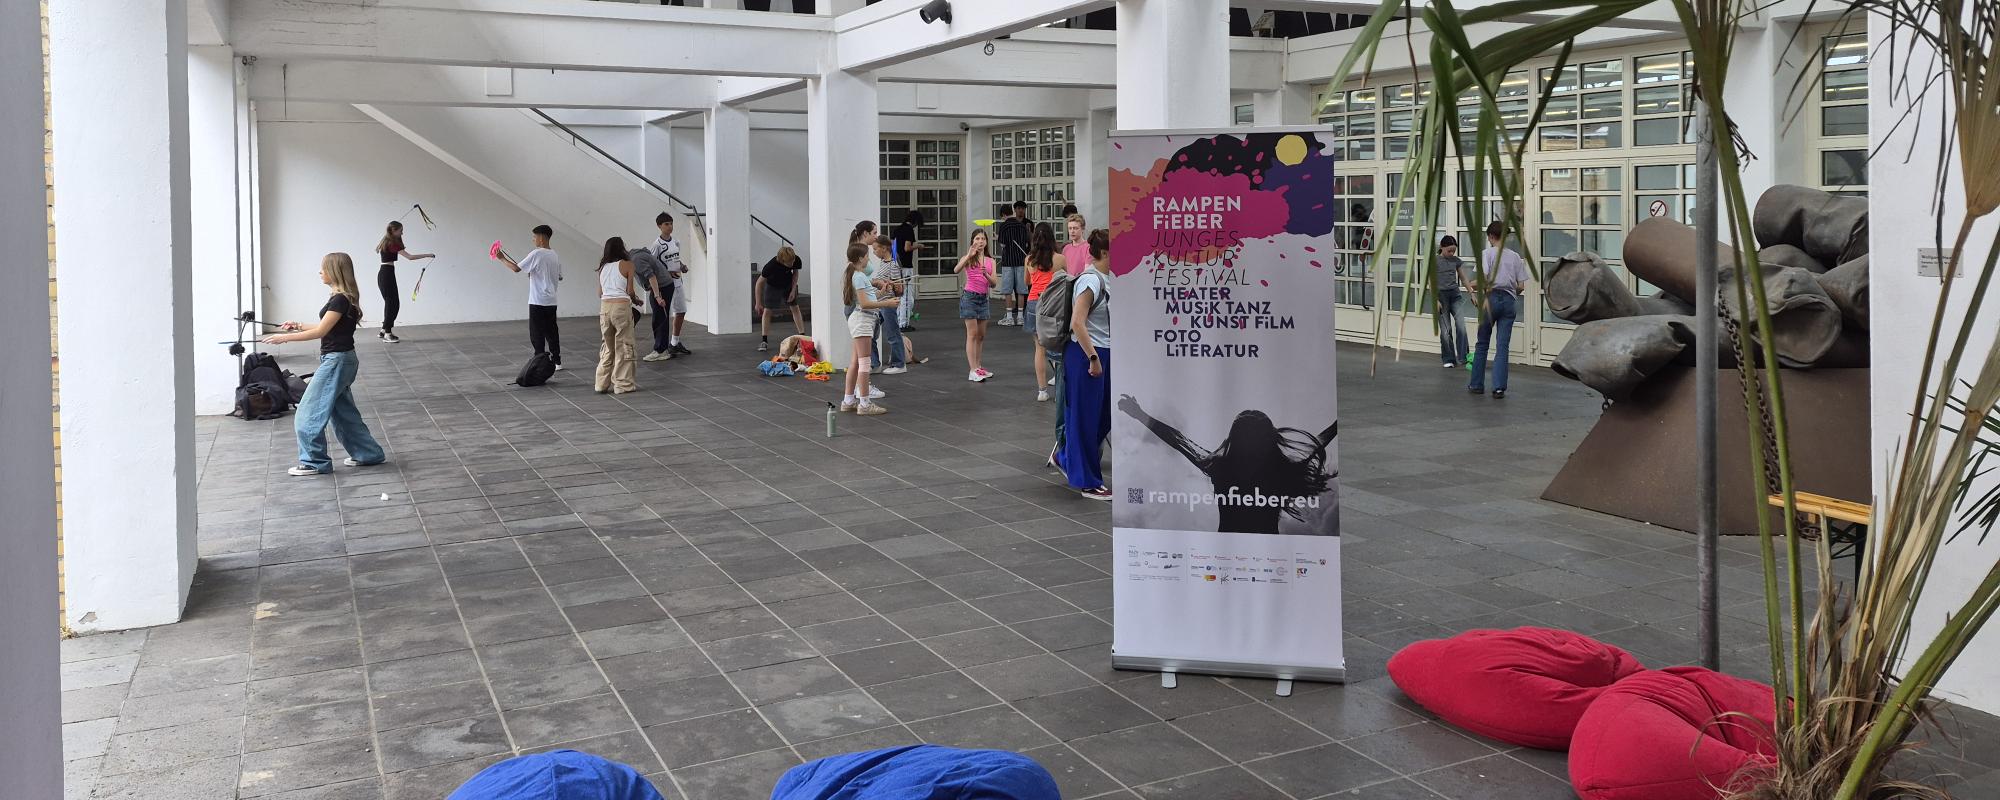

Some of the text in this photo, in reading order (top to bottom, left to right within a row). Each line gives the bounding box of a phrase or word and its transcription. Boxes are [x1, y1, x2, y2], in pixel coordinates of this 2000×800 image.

[1153, 195, 1241, 212] RAMPEN
[1151, 230, 1240, 248] JUNGES
[1153, 249, 1235, 267] KULTUR
[1152, 287, 1231, 300] THEATER
[1225, 301, 1271, 315] TANZ
[1190, 315, 1250, 329] KUNST
[1154, 329, 1202, 343] FOTO
[1149, 486, 1320, 512] rampenfieber.eu
